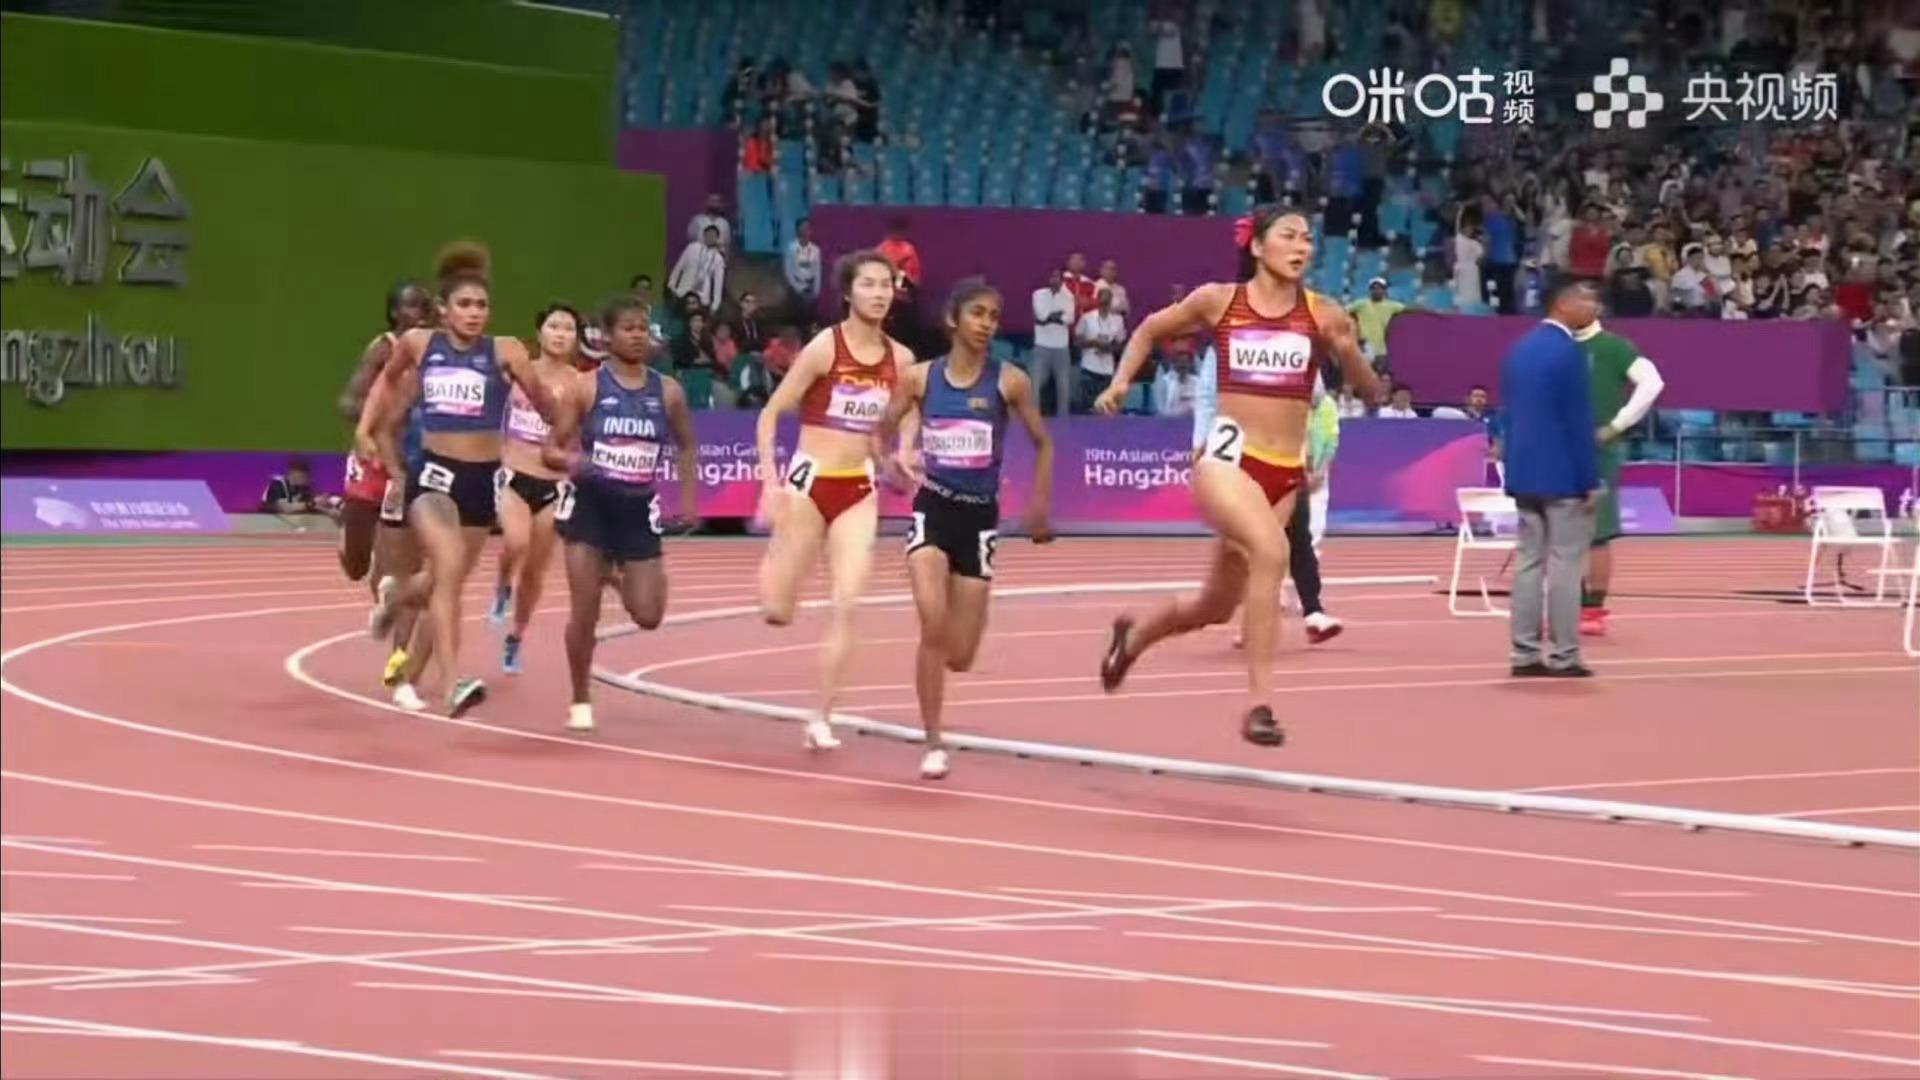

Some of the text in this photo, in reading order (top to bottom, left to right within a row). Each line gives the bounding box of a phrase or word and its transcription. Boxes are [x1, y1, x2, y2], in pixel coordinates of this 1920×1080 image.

[1236, 347, 1304, 369] WANG
[425, 382, 483, 401] BAINS
[603, 416, 656, 437] INDIA
[1213, 423, 1240, 462] 2
[1118, 448, 1159, 463] Asian
[789, 460, 812, 491] 4
[1083, 463, 1194, 490] Hangzho
